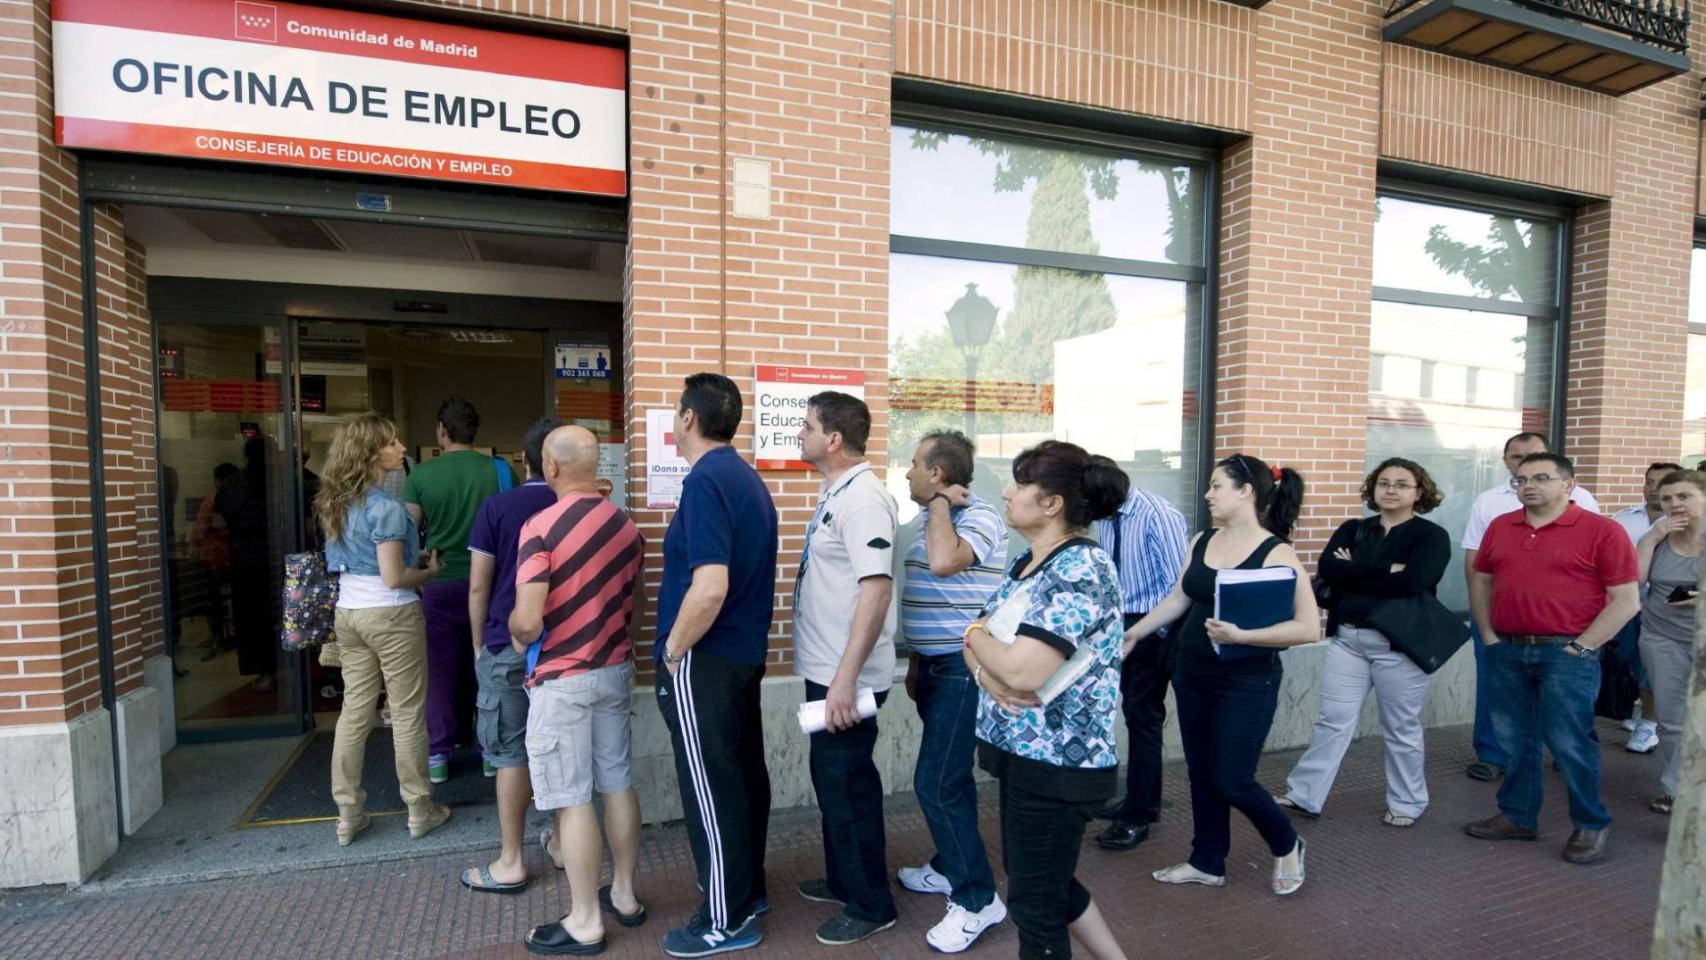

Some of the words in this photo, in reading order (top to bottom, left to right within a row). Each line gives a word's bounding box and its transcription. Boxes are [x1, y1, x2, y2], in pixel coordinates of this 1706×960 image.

[286, 20, 388, 46] Comunidad
[393, 35, 415, 49] de
[420, 38, 478, 58] Madrid
[112, 58, 314, 111] OFICINA
[328, 81, 388, 119] DE
[404, 89, 581, 139] EMPLEO
[195, 135, 305, 158] CONSEJERÍA
[309, 146, 332, 160] DE
[336, 148, 432, 170] EDUCACIÓN
[436, 159, 446, 171] Y
[449, 160, 513, 177] EMPLEO
[760, 393, 808, 408] Conse
[760, 412, 805, 427] Educa
[760, 435, 768, 449] y
